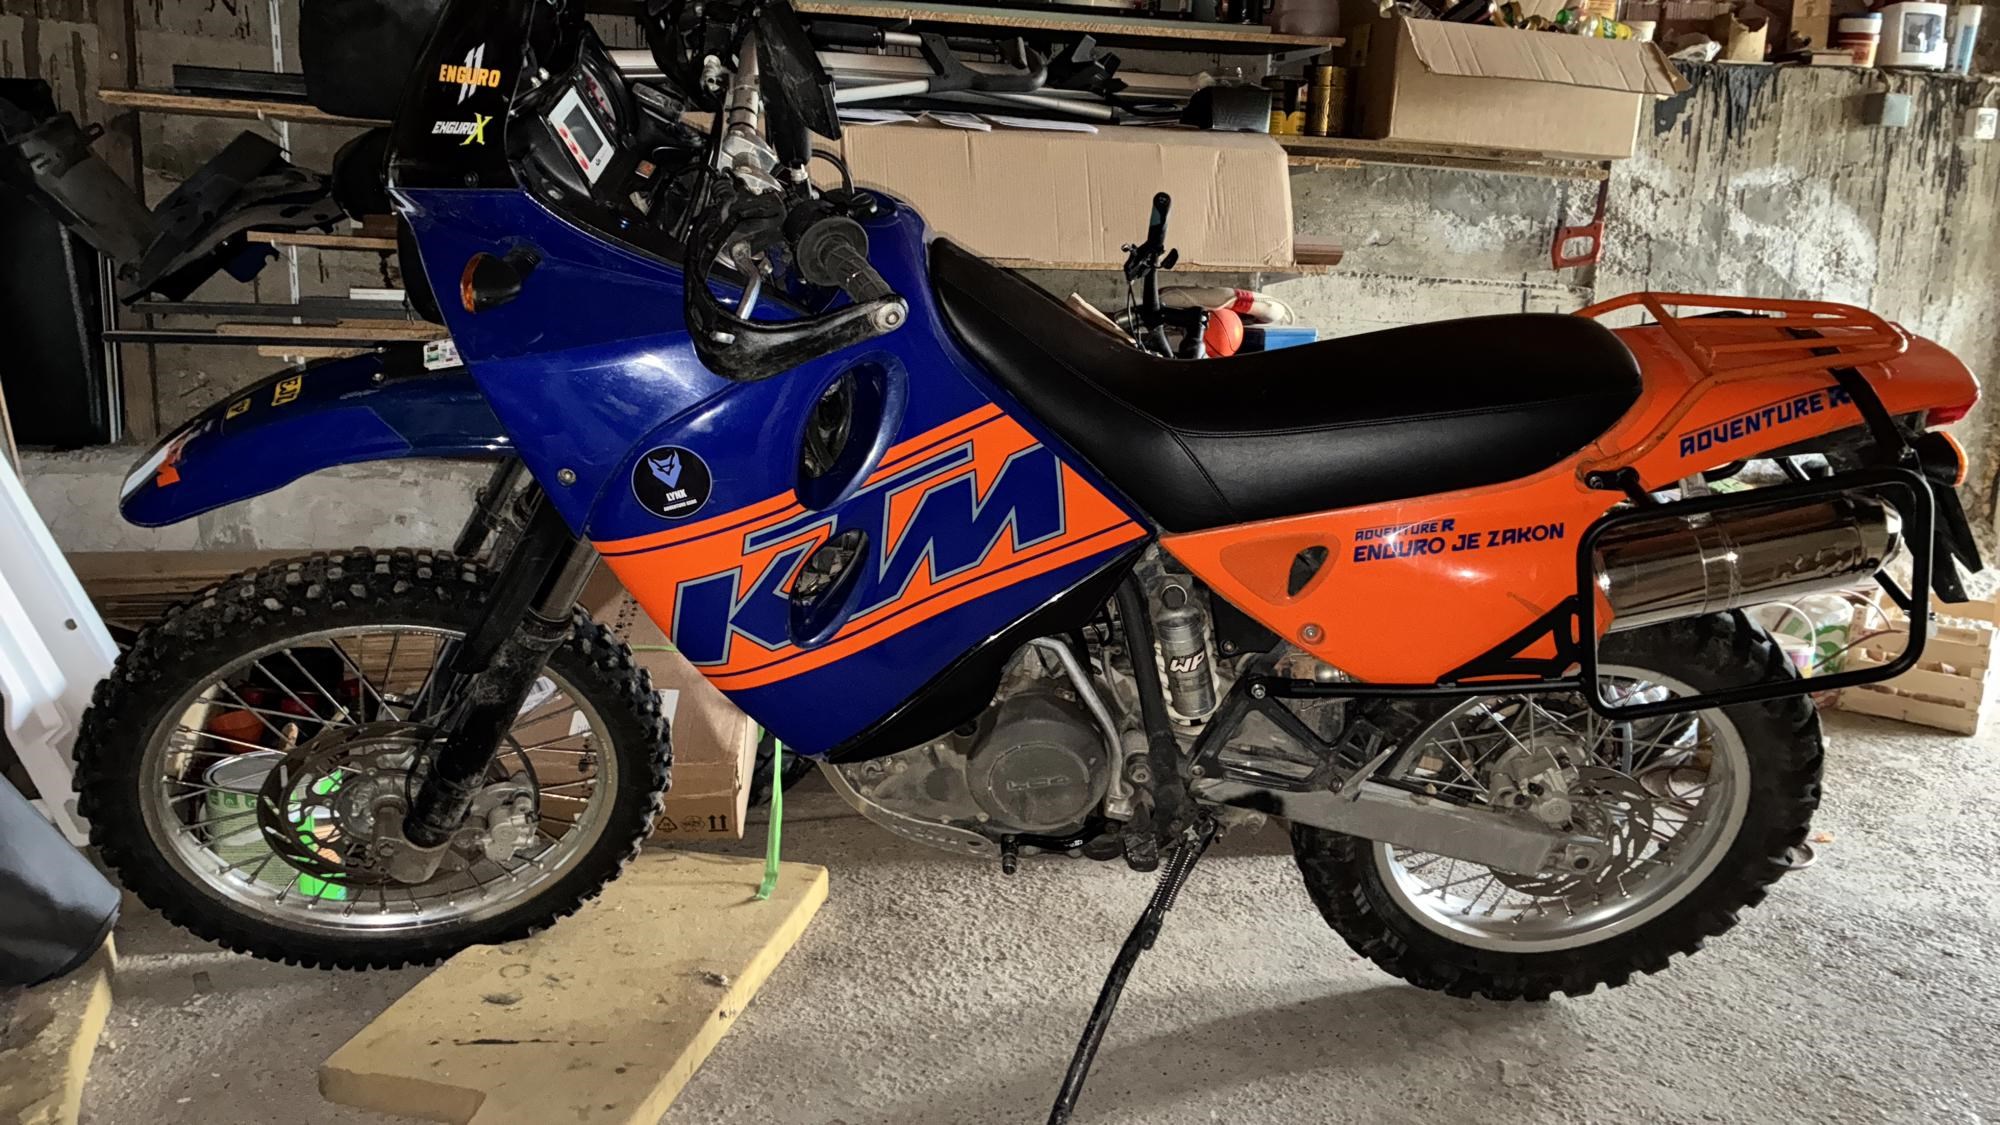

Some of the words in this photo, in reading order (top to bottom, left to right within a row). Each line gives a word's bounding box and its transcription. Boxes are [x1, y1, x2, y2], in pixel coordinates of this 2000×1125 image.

[1680, 393, 1824, 458] ADVENTURE
[665, 488, 688, 502] LYNX
[1353, 536, 1446, 563] ENDURO
[1451, 533, 1482, 552] JE
[1487, 522, 1565, 548] ZAKON
[1355, 522, 1439, 541] ADVENTURE
[1441, 518, 1456, 532] R
[670, 441, 1067, 666] KTM
[1169, 650, 1205, 673] WP
